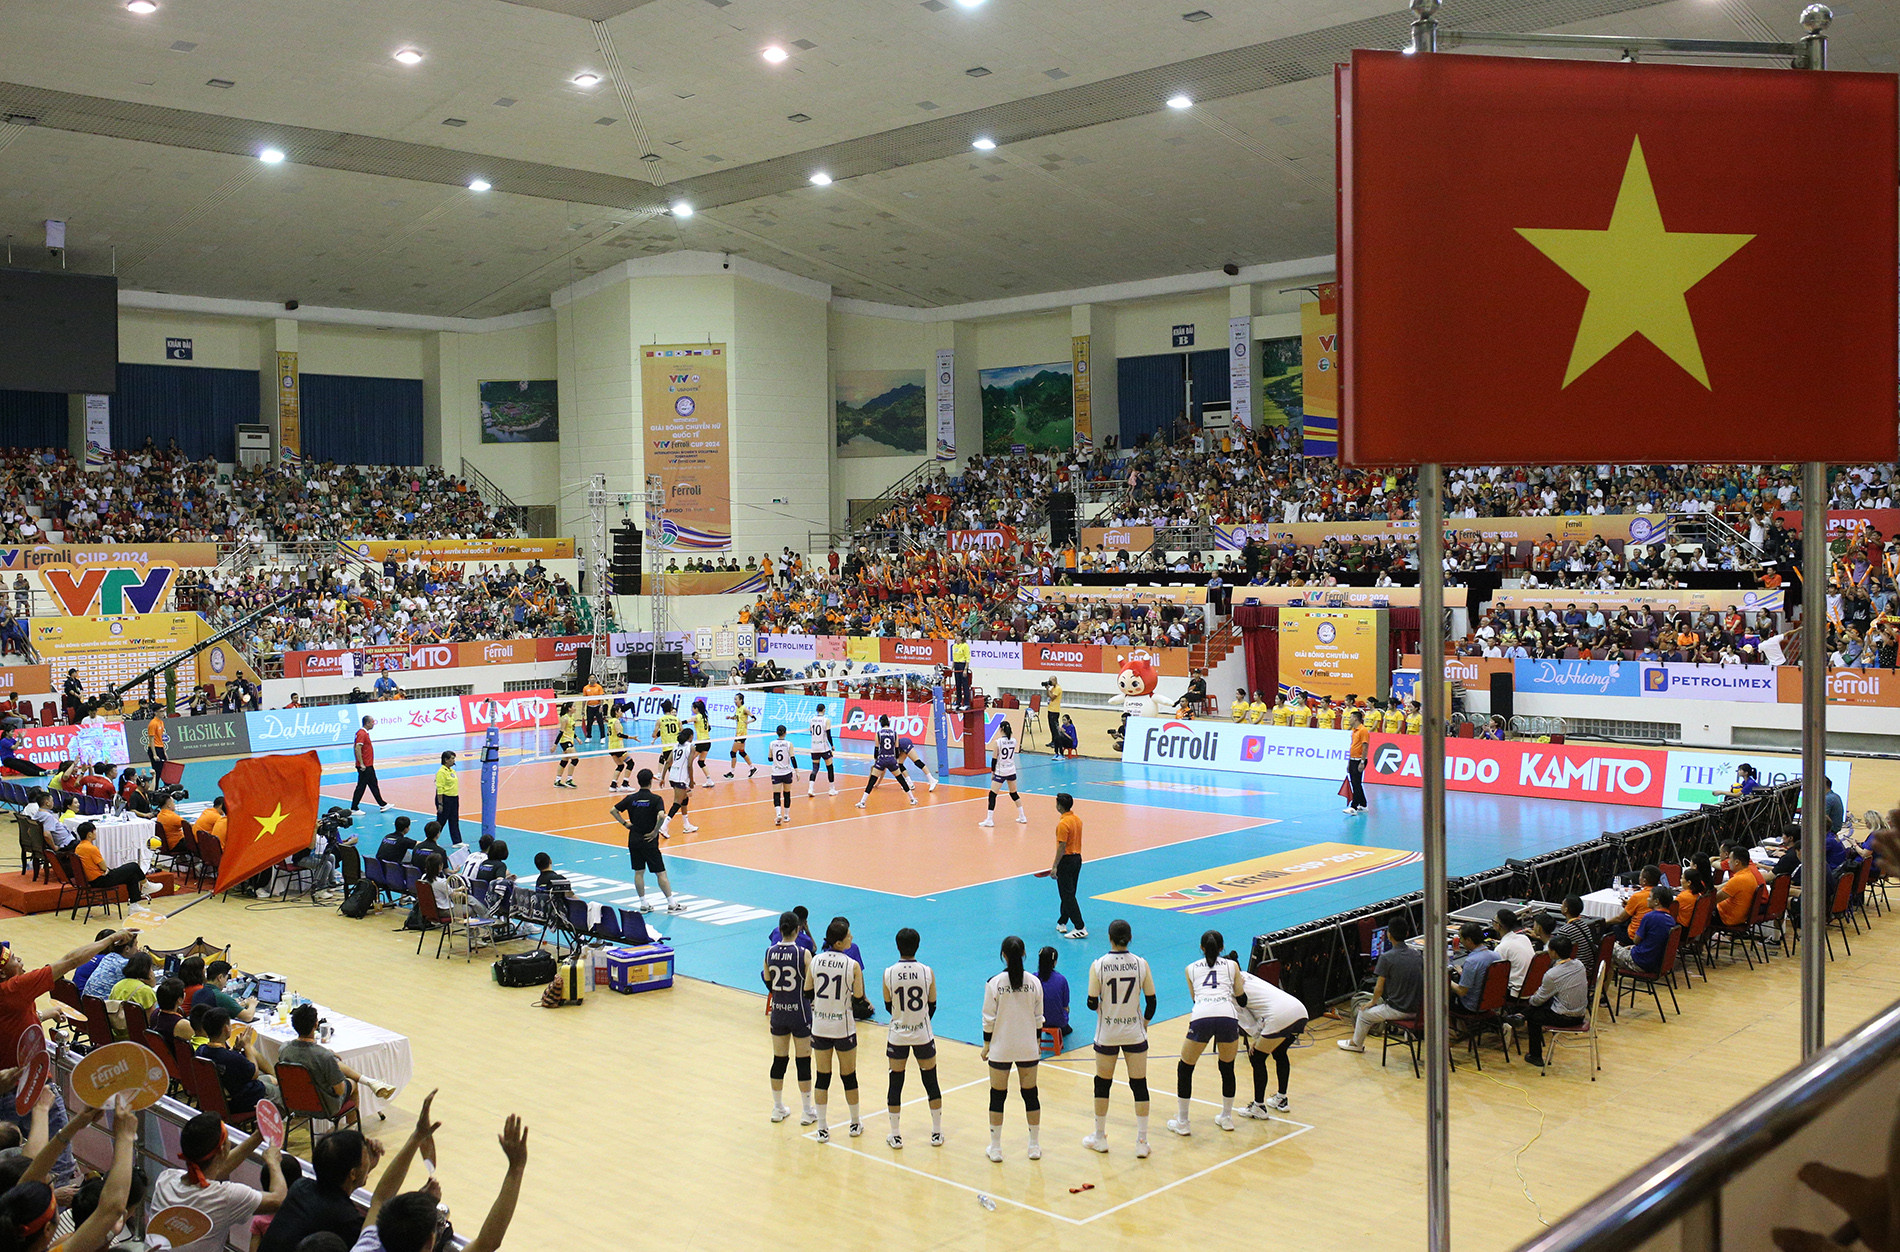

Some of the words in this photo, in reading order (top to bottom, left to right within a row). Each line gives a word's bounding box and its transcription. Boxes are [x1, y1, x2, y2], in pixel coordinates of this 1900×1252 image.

[1178, 336, 1189, 345] B
[174, 348, 186, 358] C
[669, 374, 689, 384] VTV
[653, 440, 670, 448] VTV
[671, 483, 701, 497] Ferroli
[1103, 530, 1130, 546] Ferroli
[1458, 529, 1481, 539] Ferroli
[23, 546, 71, 568] Ferroli
[75, 551, 107, 565] CUP
[112, 551, 149, 564] 2024
[45, 567, 172, 617] VTV
[1302, 591, 1323, 601] VTV
[1324, 590, 1349, 603] Ferroli
[1350, 593, 1366, 601] CUP
[616, 640, 684, 652] USPOTS
[738, 635, 752, 646] 08
[769, 642, 814, 651] PETROLIMEX
[484, 643, 513, 660] Ferroli
[895, 642, 932, 656] RAPIDO
[970, 650, 1020, 659] ETROLIMEX
[1041, 649, 1084, 662] RAPIDO
[306, 654, 342, 667] RAPI
[409, 645, 452, 668] MITO
[1444, 659, 1478, 680] erroli
[1672, 676, 1772, 689] PETROLIMEX
[1826, 671, 1880, 697] Ferroli
[468, 696, 549, 725] KAMITO
[177, 721, 236, 742] HaSilk.K
[665, 723, 677, 734] 10
[812, 725, 822, 736] 10
[37, 732, 66, 750] GIẶT
[883, 738, 892, 750] 8
[1143, 722, 1219, 762] Ferroli
[29, 750, 69, 764] GIANG
[674, 749, 683, 760] 19
[776, 750, 783, 761] 6
[1001, 747, 1015, 760] 97
[1267, 744, 1351, 761] PETROLIME
[1375, 748, 1500, 783] RAIDO
[1519, 752, 1651, 794] KAMITO
[1680, 765, 1716, 785] TH
[464, 861, 477, 877] 11
[1145, 883, 1225, 901] VTV
[1217, 868, 1291, 888] Ferroli
[1282, 858, 1327, 873] CUP
[1325, 850, 1375, 863] 2024
[770, 952, 780, 961] MI
[781, 952, 793, 961] JIN
[817, 959, 827, 968] YE
[827, 960, 845, 969] EUN
[1104, 964, 1119, 972] HYUN
[1120, 963, 1137, 971] JEONG
[768, 965, 798, 992] 23
[897, 972, 907, 981] SE
[909, 972, 918, 980] IN
[1202, 970, 1220, 989] 4
[817, 973, 843, 1000] 21
[1106, 977, 1136, 1004] 17
[894, 985, 924, 1012] 18
[90, 1058, 129, 1088] Ferroli
